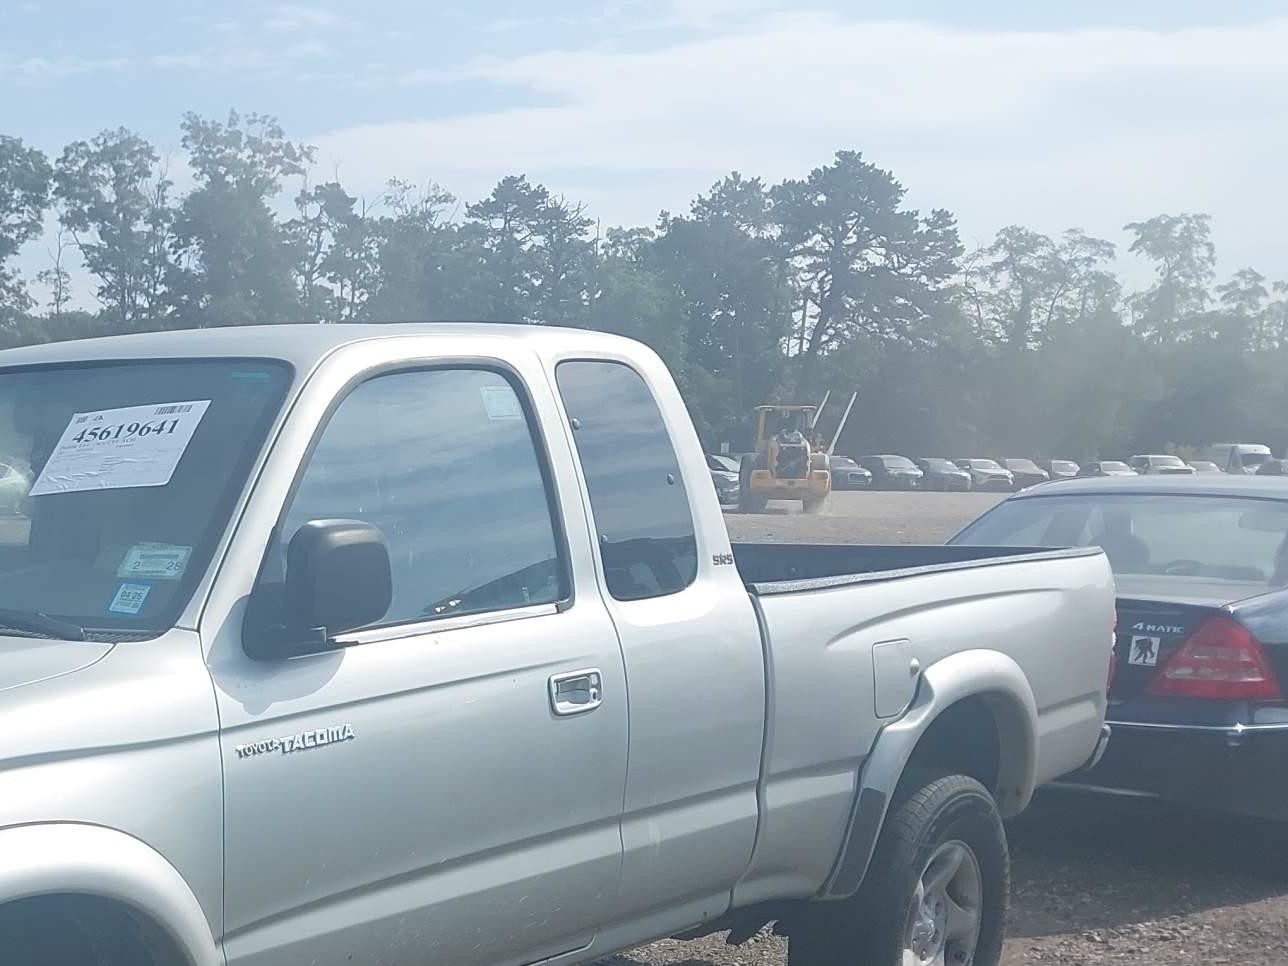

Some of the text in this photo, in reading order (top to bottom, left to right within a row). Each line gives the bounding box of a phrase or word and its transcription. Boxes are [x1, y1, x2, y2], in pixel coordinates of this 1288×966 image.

[72, 418, 180, 443] 45619641
[236, 723, 356, 759] TOYOTA TACOMA
